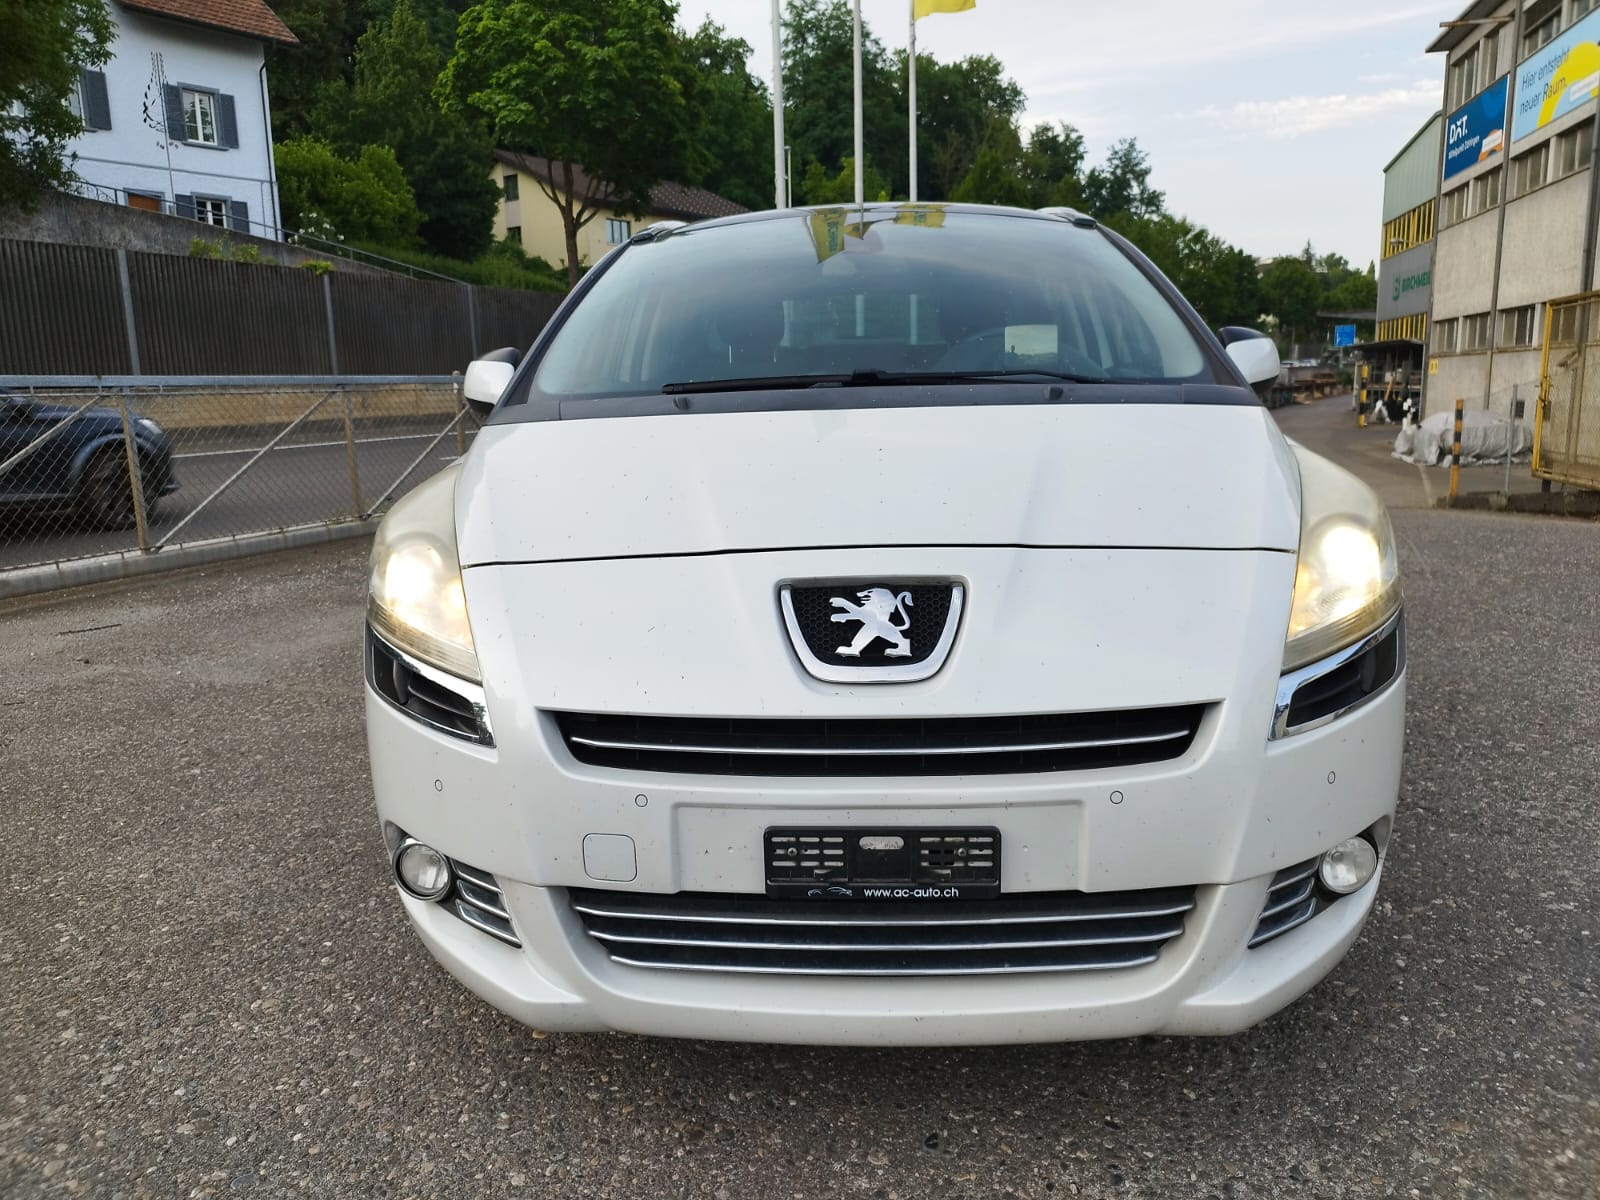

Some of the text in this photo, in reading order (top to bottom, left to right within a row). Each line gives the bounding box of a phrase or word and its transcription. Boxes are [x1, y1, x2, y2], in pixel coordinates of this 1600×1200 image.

[1521, 71, 1538, 92] Hier
[1519, 91, 1542, 115] neuer
[863, 887, 959, 898] www.ac-auto.ch
